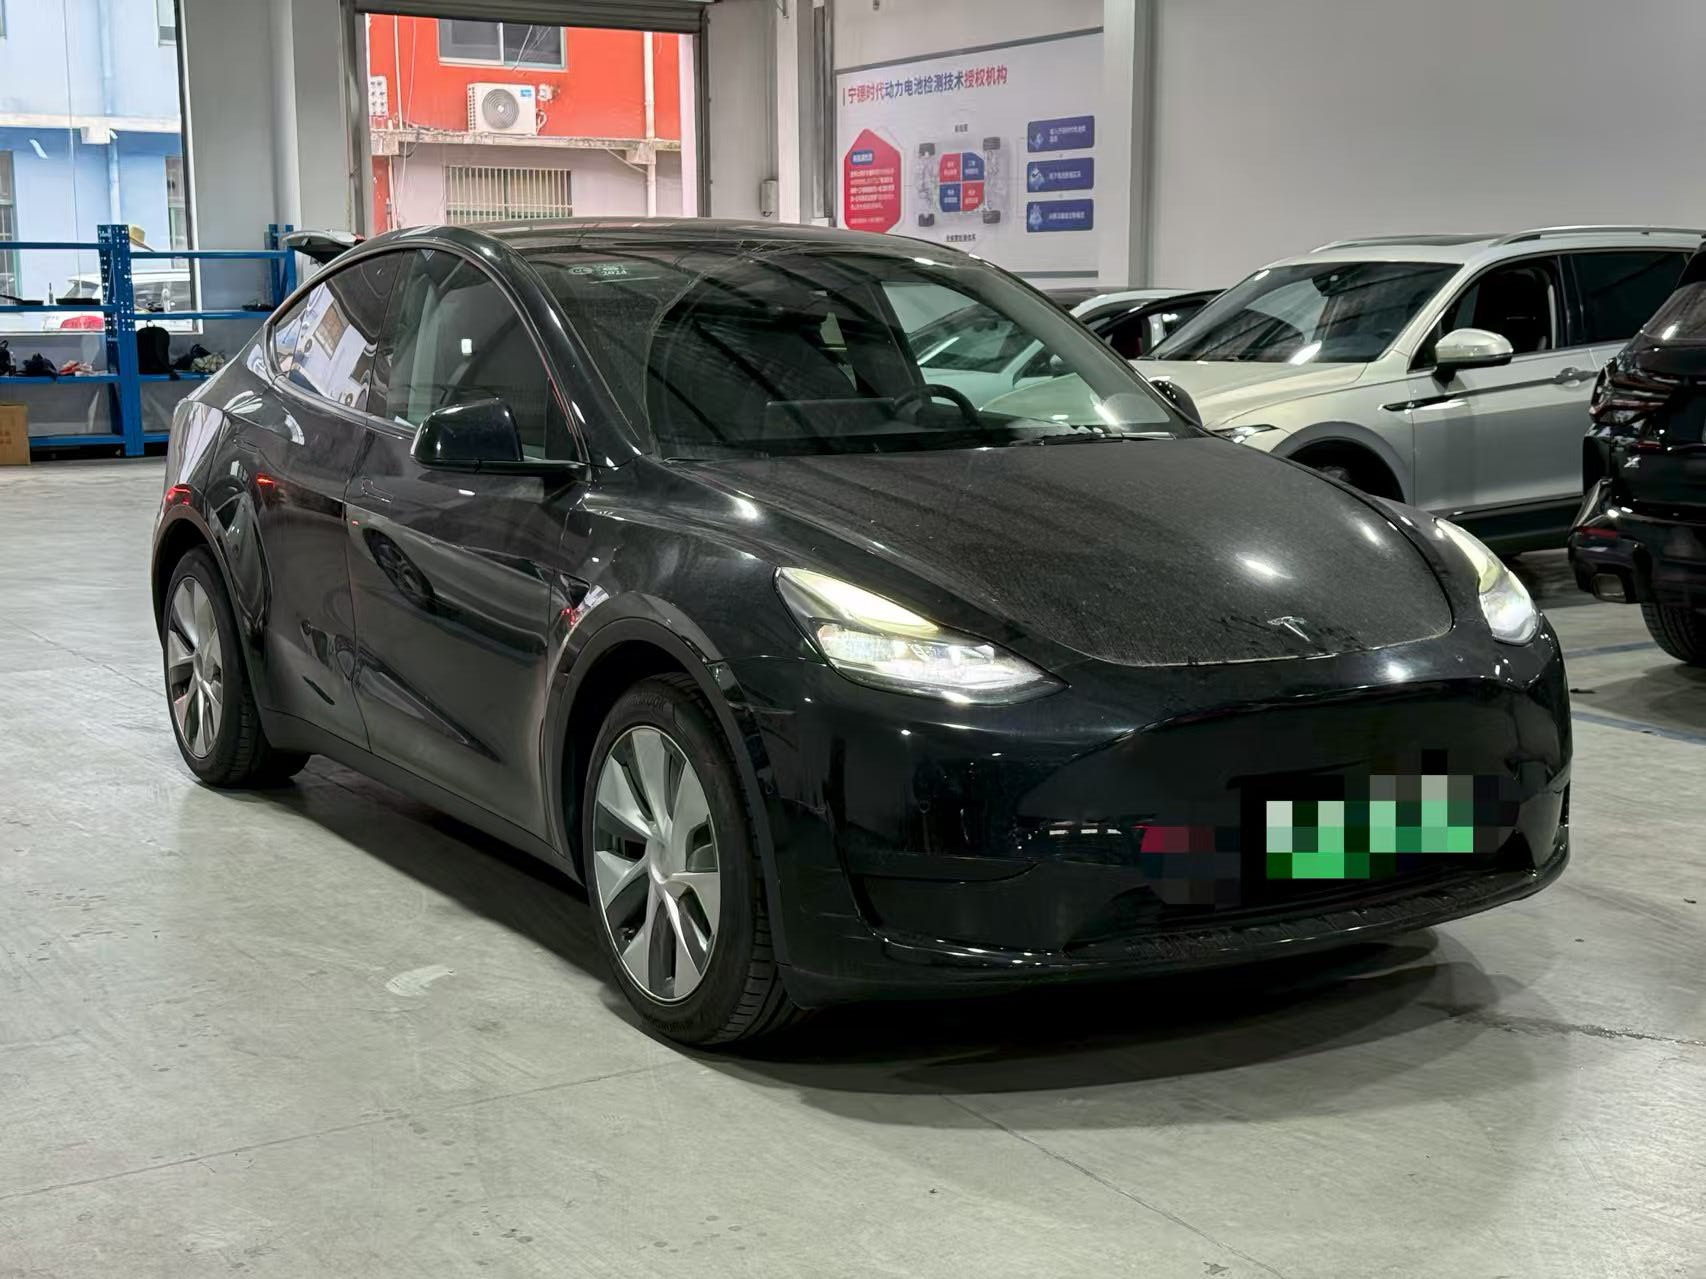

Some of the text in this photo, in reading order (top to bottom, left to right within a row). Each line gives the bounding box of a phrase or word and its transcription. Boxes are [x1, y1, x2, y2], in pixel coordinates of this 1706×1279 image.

[848, 64, 1008, 104] 宁德时代动力电池检测技术授权机构
